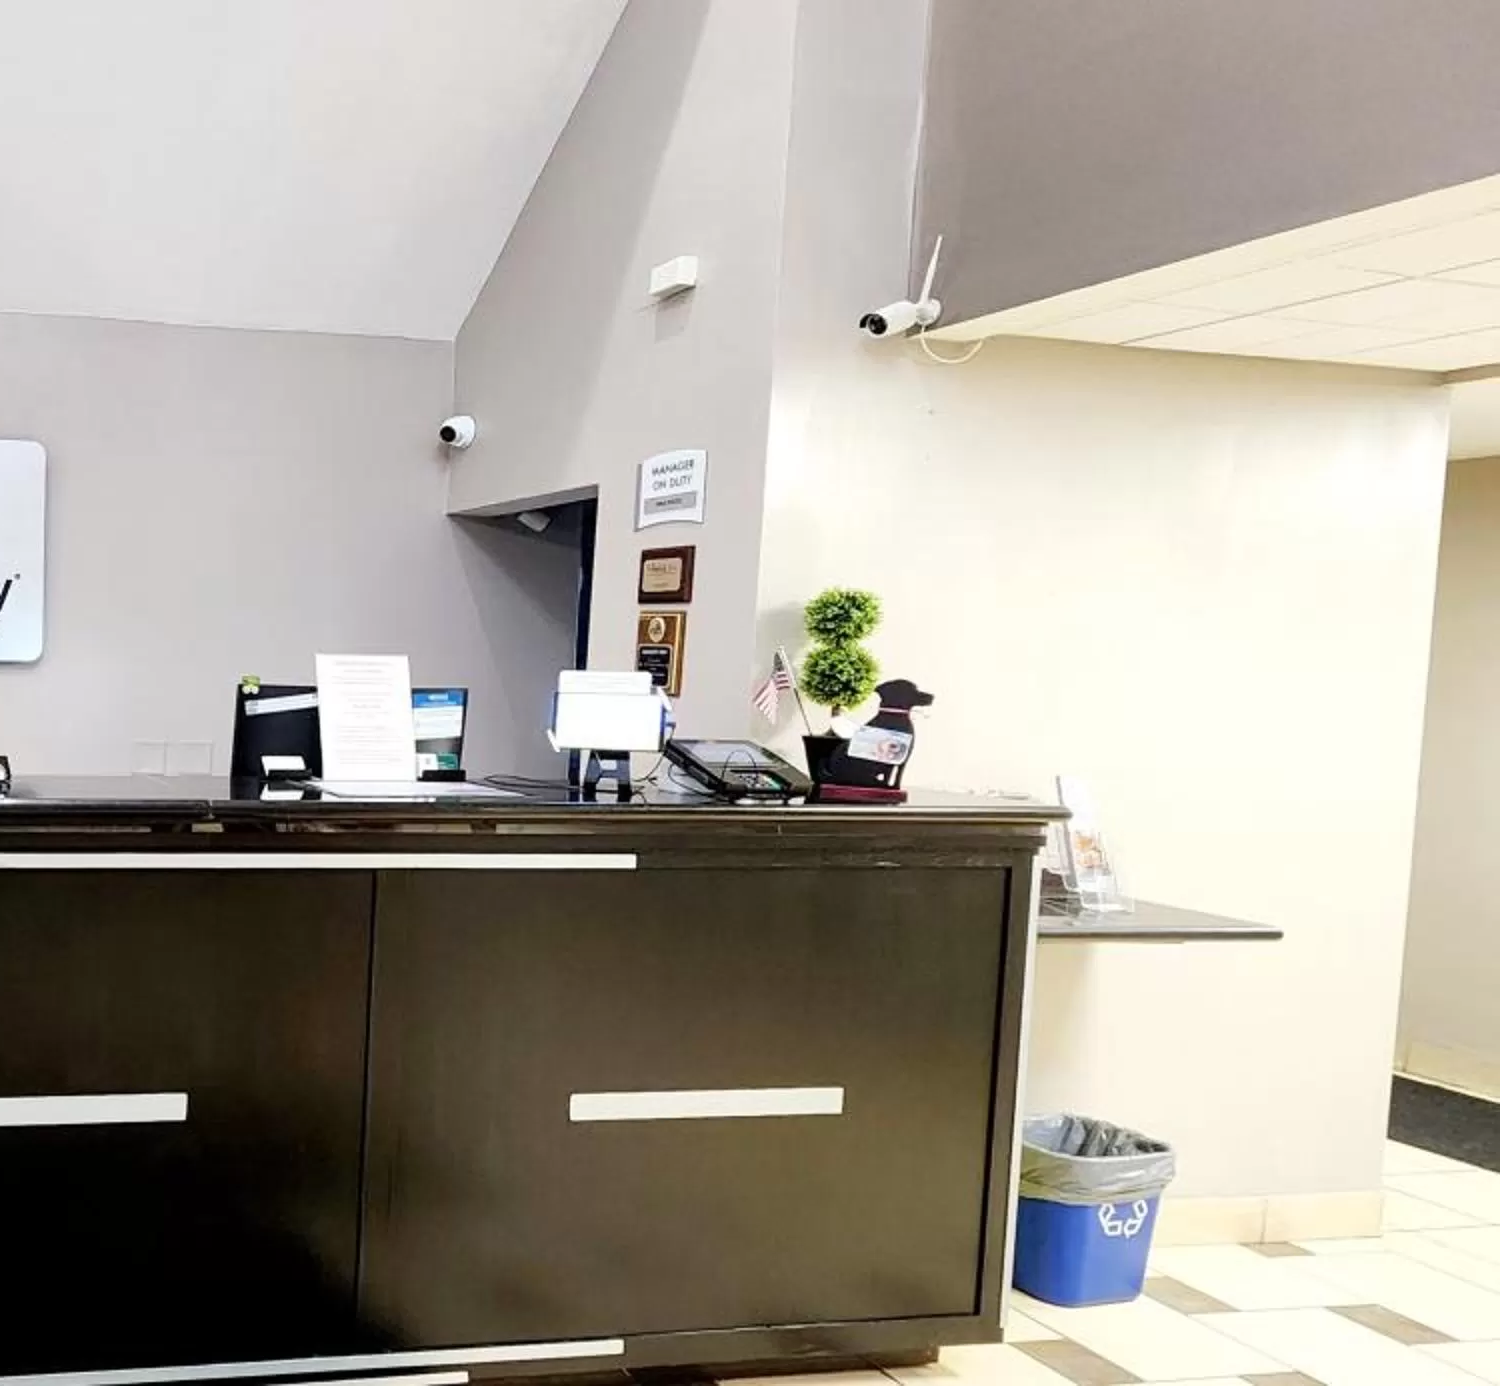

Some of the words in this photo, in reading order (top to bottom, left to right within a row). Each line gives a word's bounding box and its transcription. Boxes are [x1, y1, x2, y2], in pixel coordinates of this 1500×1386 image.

[652, 459, 695, 476] MANAGER
[652, 480, 666, 490] ON
[669, 475, 692, 488] DUTY
